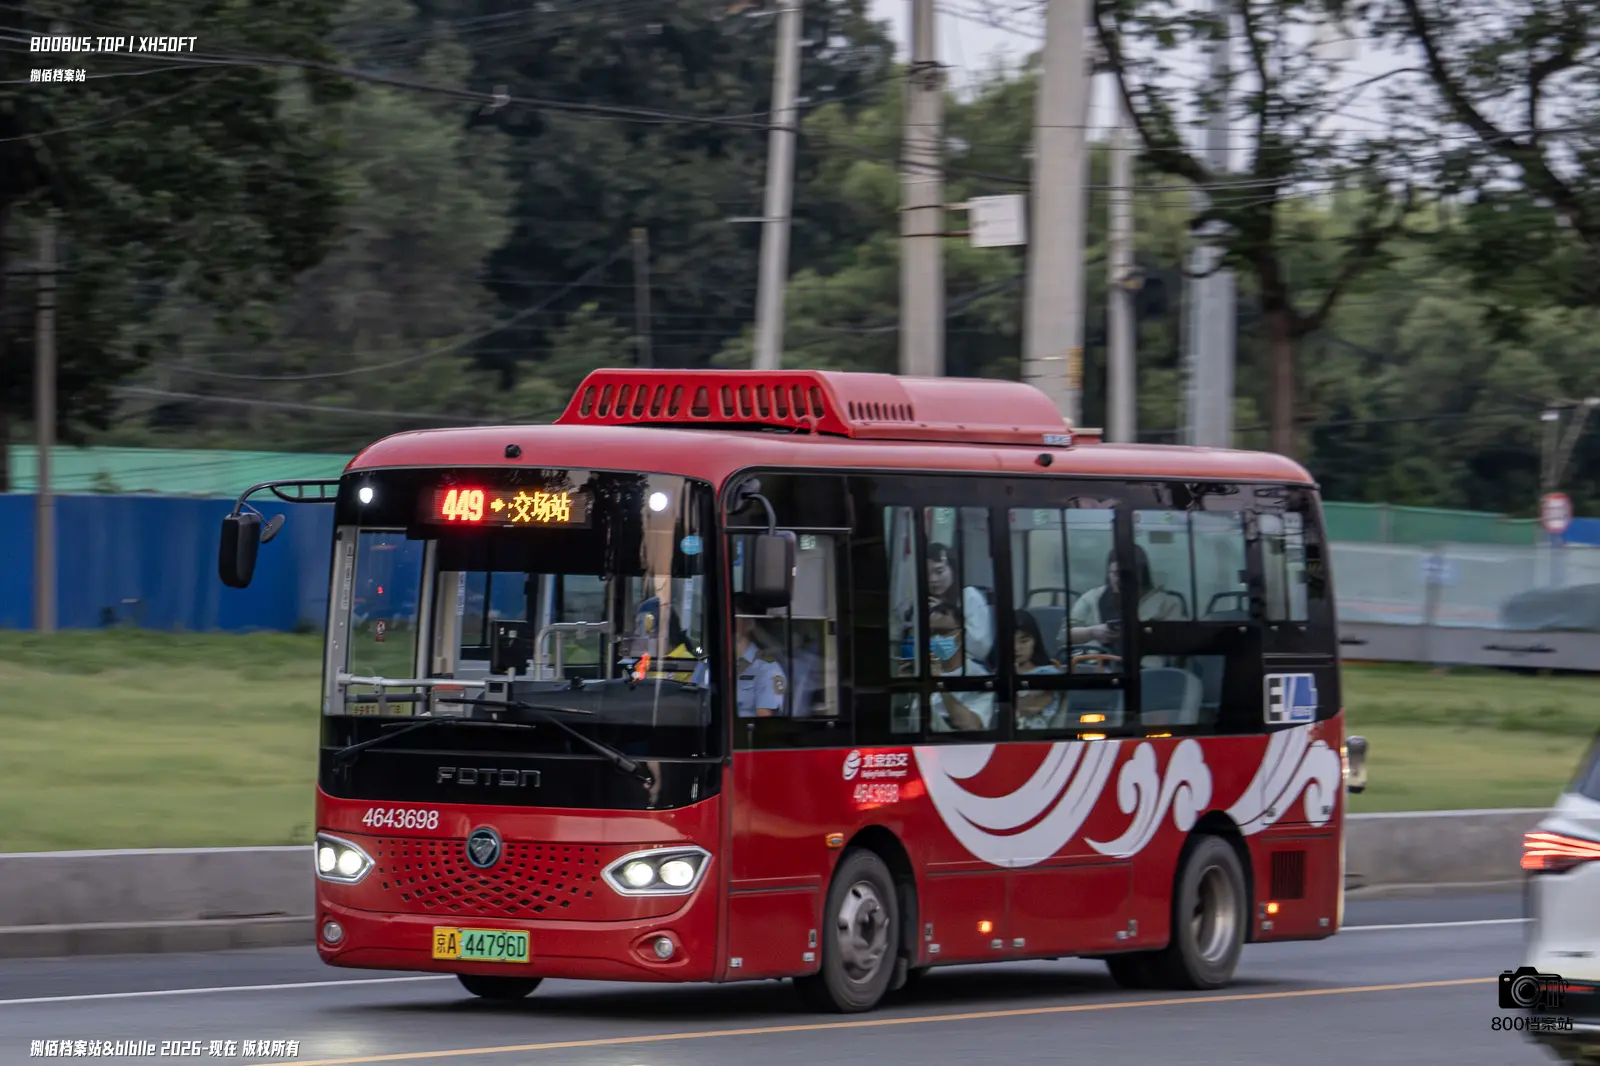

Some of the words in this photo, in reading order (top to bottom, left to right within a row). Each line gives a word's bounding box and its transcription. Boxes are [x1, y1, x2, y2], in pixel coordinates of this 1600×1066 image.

[442, 489, 485, 521] 449
[508, 491, 572, 522] 交场站
[436, 766, 541, 787] FOTON
[362, 807, 440, 830] 4643698
